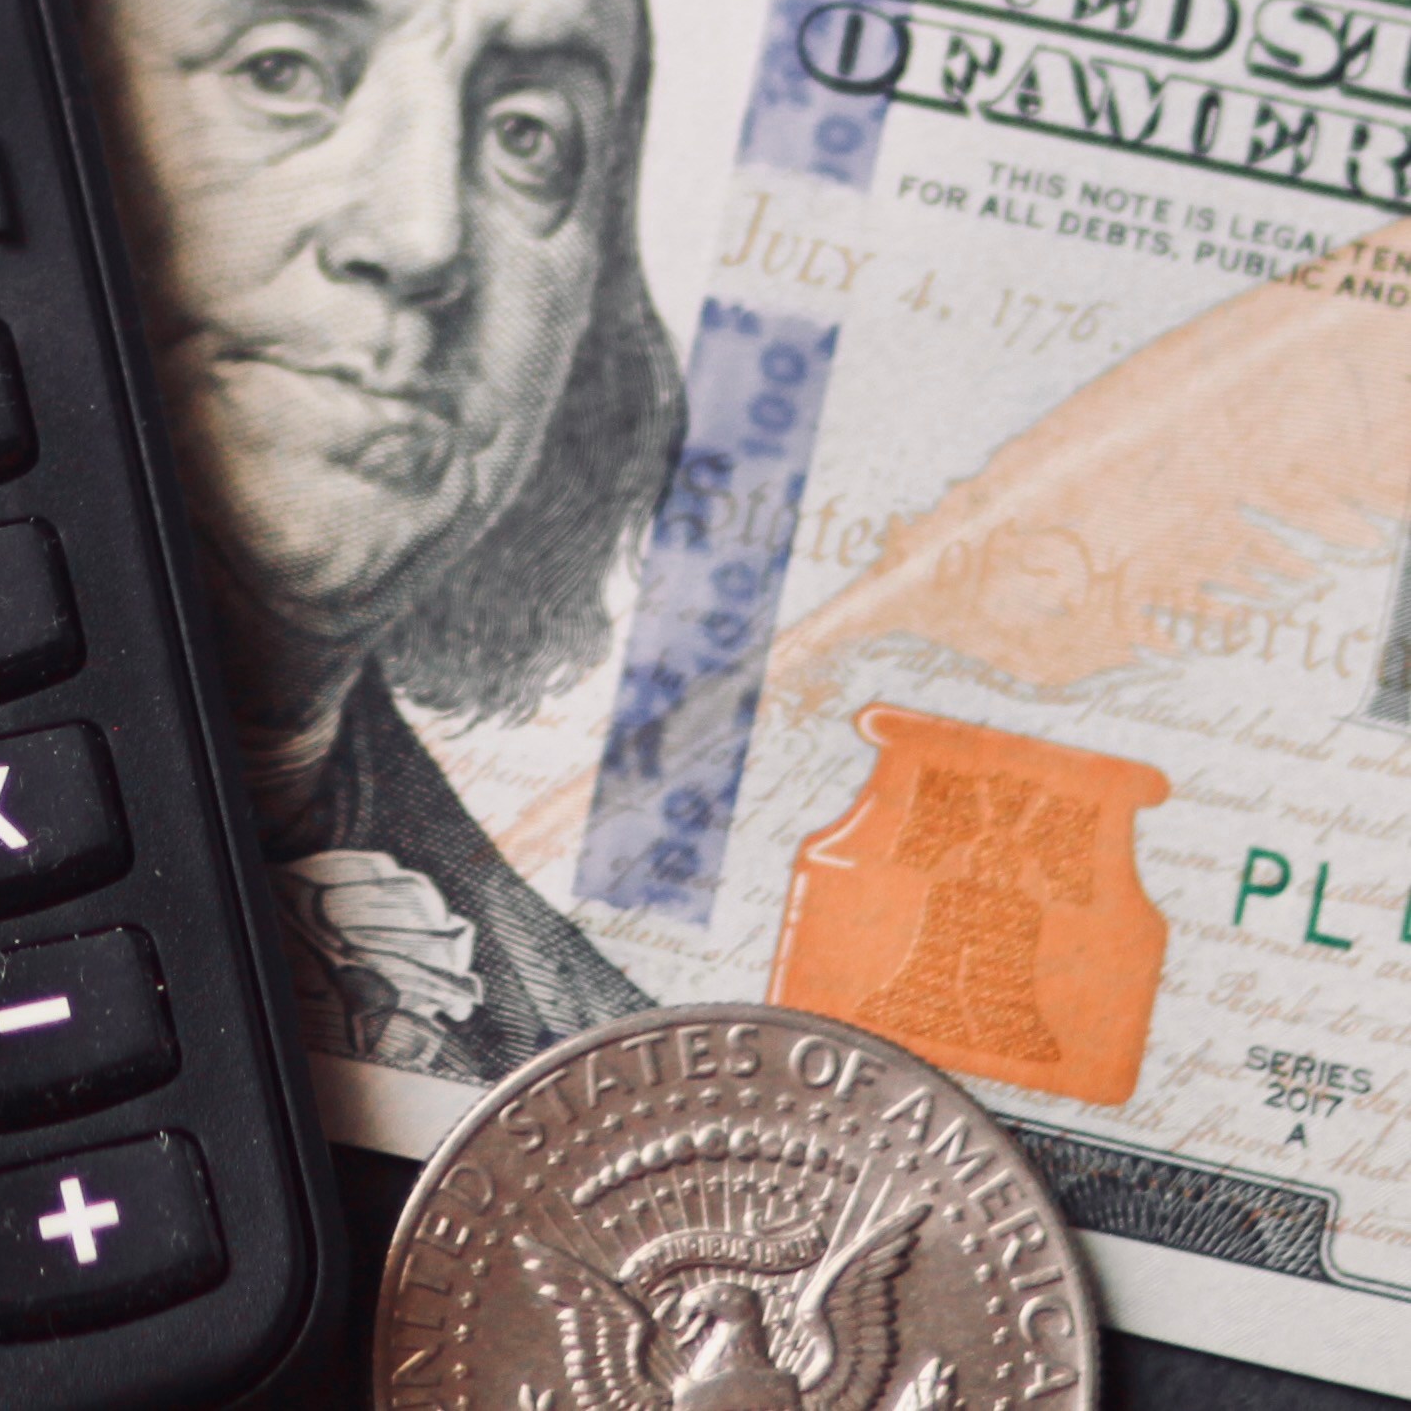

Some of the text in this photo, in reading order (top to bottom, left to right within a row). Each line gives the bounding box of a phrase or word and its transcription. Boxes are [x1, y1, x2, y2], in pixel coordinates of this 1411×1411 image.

[796, 0, 1003, 117] OF
[898, 174, 968, 213] FOR
[980, 194, 1044, 230] ALL
[1194, 240, 1327, 291] PUBLIC
[988, 160, 1067, 200] THIS
[1079, 181, 1173, 224] NOTE
[1184, 204, 1218, 234] IS
[1228, 215, 1339, 262] LEGAL
[1245, 1044, 1374, 1095] SERIES
[1261, 1079, 1345, 1119] 2017
[1284, 1121, 1310, 1150] A
[498, 1023, 763, 1154] STATES
[788, 1034, 888, 1101] OF
[880, 1085, 1080, 1402] AMERICA
